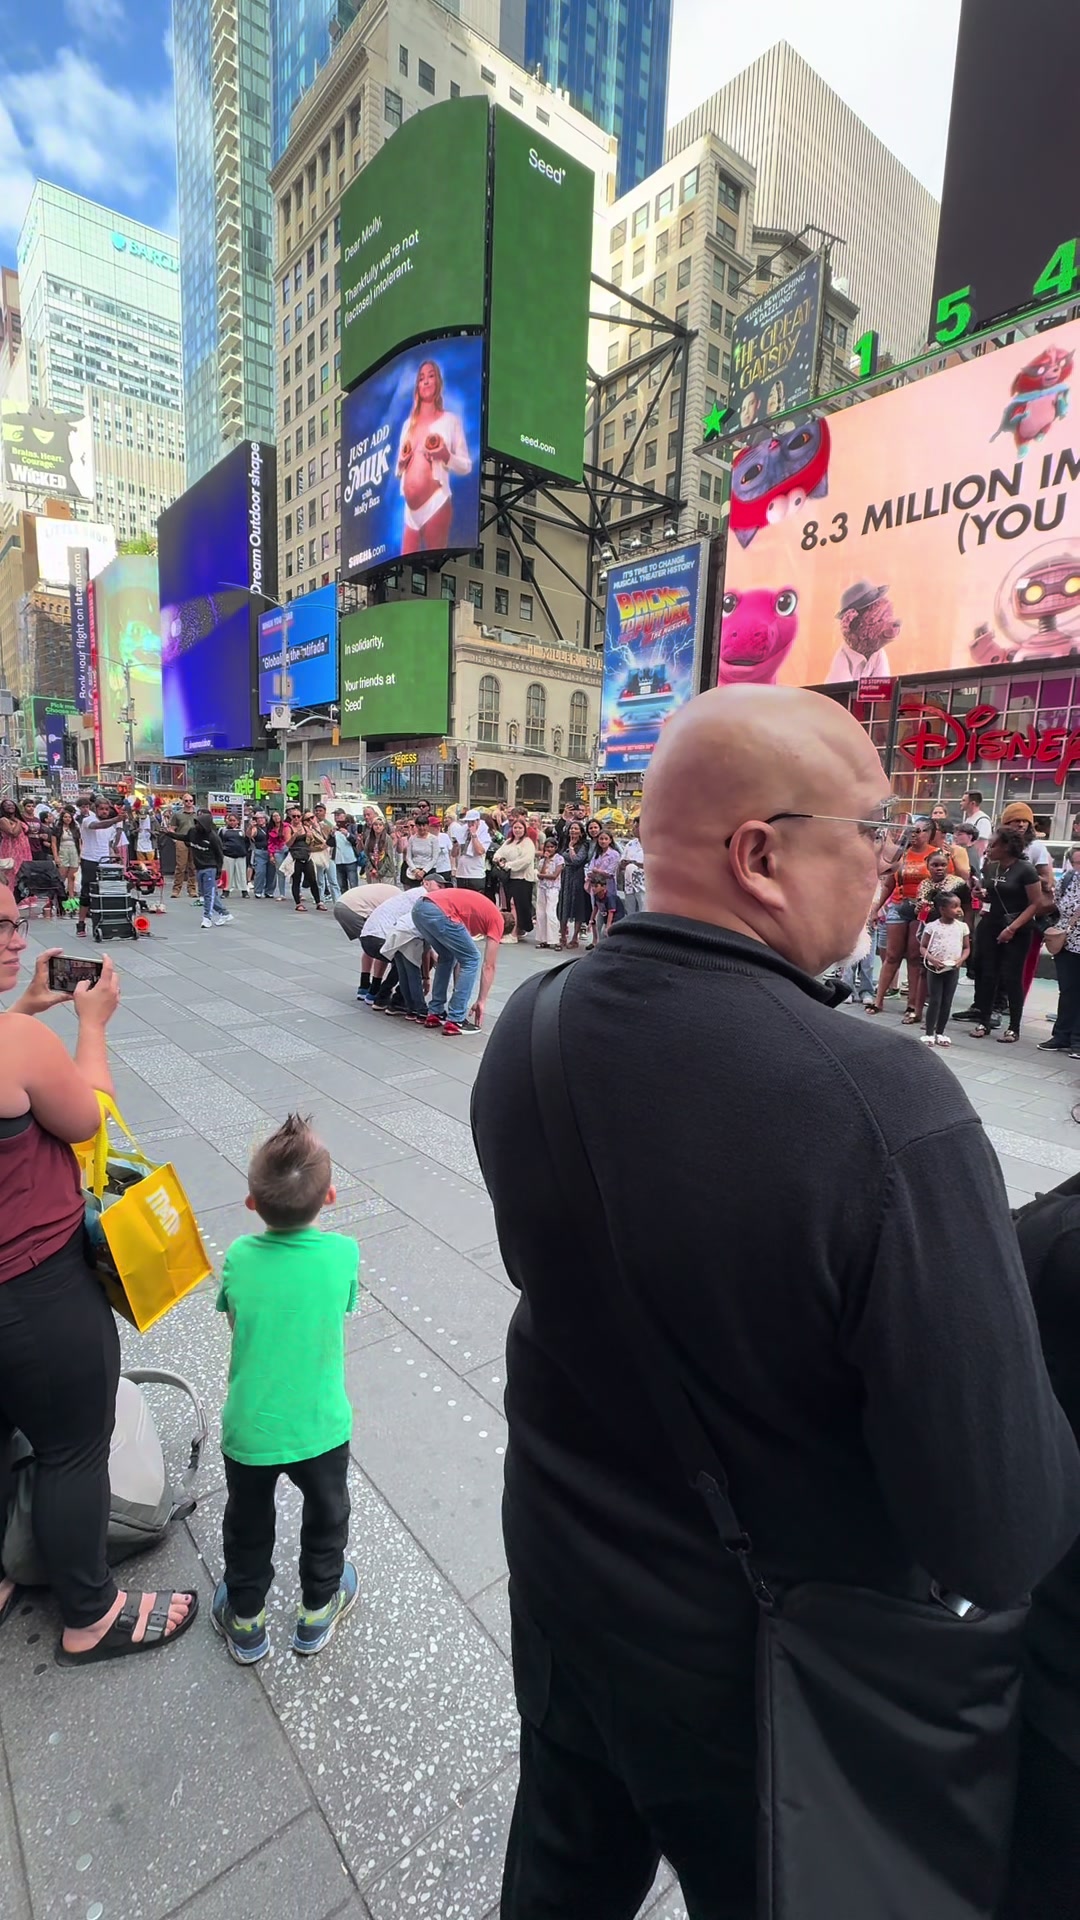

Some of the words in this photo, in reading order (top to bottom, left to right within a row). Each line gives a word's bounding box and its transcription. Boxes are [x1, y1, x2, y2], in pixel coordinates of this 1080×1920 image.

[344, 237, 361, 263] Dear
[361, 216, 383, 245] Molly,
[344, 263, 379, 305] Thankfully
[379, 243, 401, 271] we're
[402, 228, 419, 251] not
[344, 288, 373, 328] (lactose)
[373, 257, 414, 299] intolerant.
[760, 296, 813, 352] GREAT
[739, 330, 801, 391] GATSBY
[11, 446, 40, 459] Brains.
[40, 451, 65, 463] Heart.
[348, 437, 369, 467] JUST
[369, 424, 390, 449] ADD
[520, 432, 557, 456] seed.com
[21, 456, 56, 469] Courage.
[344, 444, 391, 503] MILK
[249, 487, 262, 547] Outdoor
[801, 512, 849, 551] 8.3
[861, 462, 1023, 535] MILLION
[958, 492, 1067, 556] (YOU
[74, 553, 83, 606] latam.com
[250, 550, 262, 594] Dream
[613, 579, 638, 589] MUSICAL
[640, 569, 667, 582] THEATER
[667, 560, 695, 574] HISTORY
[634, 566, 648, 576] TIME
[649, 564, 657, 572] TO
[658, 555, 685, 569] CHANGE
[76, 608, 84, 621] on
[614, 586, 690, 621] BACK
[634, 601, 691, 634] FUTURE
[75, 622, 87, 649] flight
[344, 643, 351, 656] In
[351, 634, 384, 654] solidarity,
[290, 647, 300, 661] the
[542, 647, 578, 665] MILLER
[344, 680, 359, 692] Your
[359, 673, 384, 689] friends
[385, 673, 396, 685] at
[213, 795, 230, 803] TSQ
